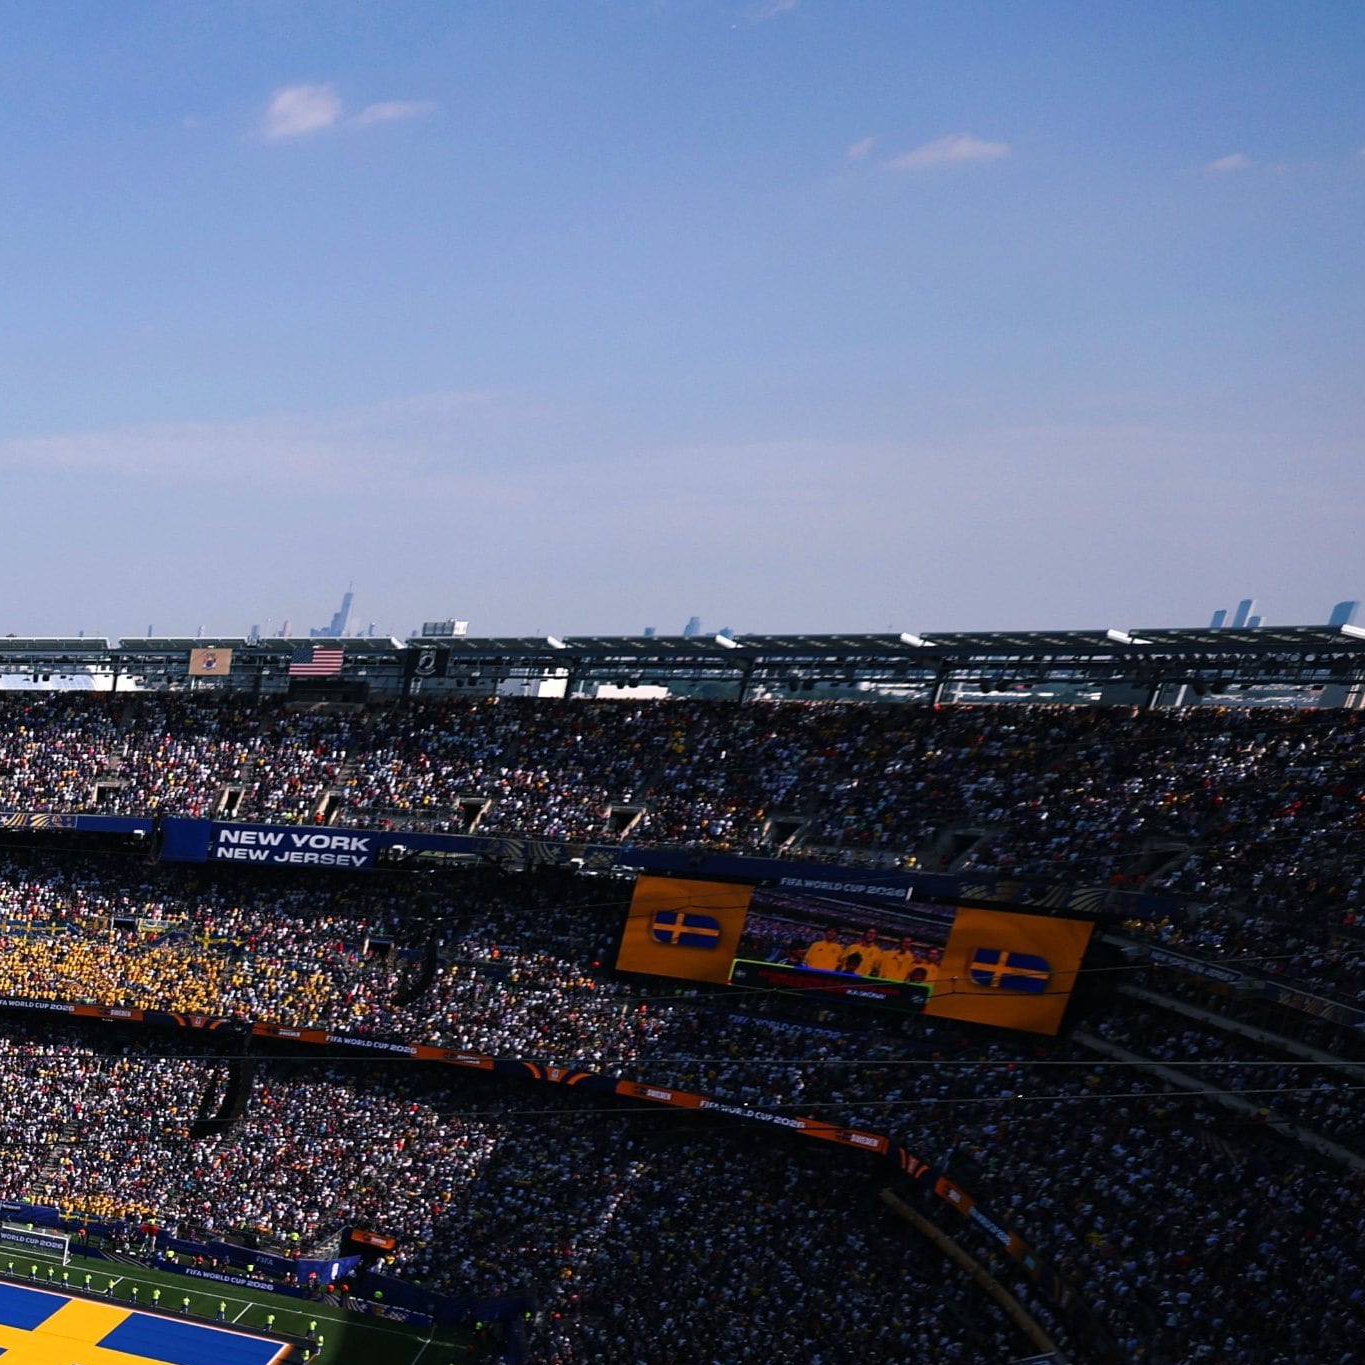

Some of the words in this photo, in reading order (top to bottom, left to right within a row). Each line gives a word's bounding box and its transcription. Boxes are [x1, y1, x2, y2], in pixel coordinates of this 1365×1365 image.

[220, 829, 284, 847] NEW
[290, 834, 370, 851] YORK
[216, 847, 270, 861] NEW
[273, 852, 368, 867] JERSEY
[780, 877, 804, 887] FIFA
[804, 879, 843, 891] WORLD
[842, 883, 867, 893] CUP
[865, 885, 907, 898] 2026
[8, 1000, 34, 1009] WORLD
[49, 1003, 75, 1012] 2026
[325, 1034, 343, 1045] FIFA
[343, 1037, 373, 1048] WORLD
[373, 1040, 389, 1050] CUP
[389, 1043, 418, 1055] 2026
[1, 1232, 24, 1243] WORLD
[25, 1236, 39, 1246] CUP
[185, 1267, 202, 1277] FIFA
[202, 1271, 229, 1283] WORLD
[230, 1275, 246, 1286] CUP
[246, 1279, 274, 1291] 2026
